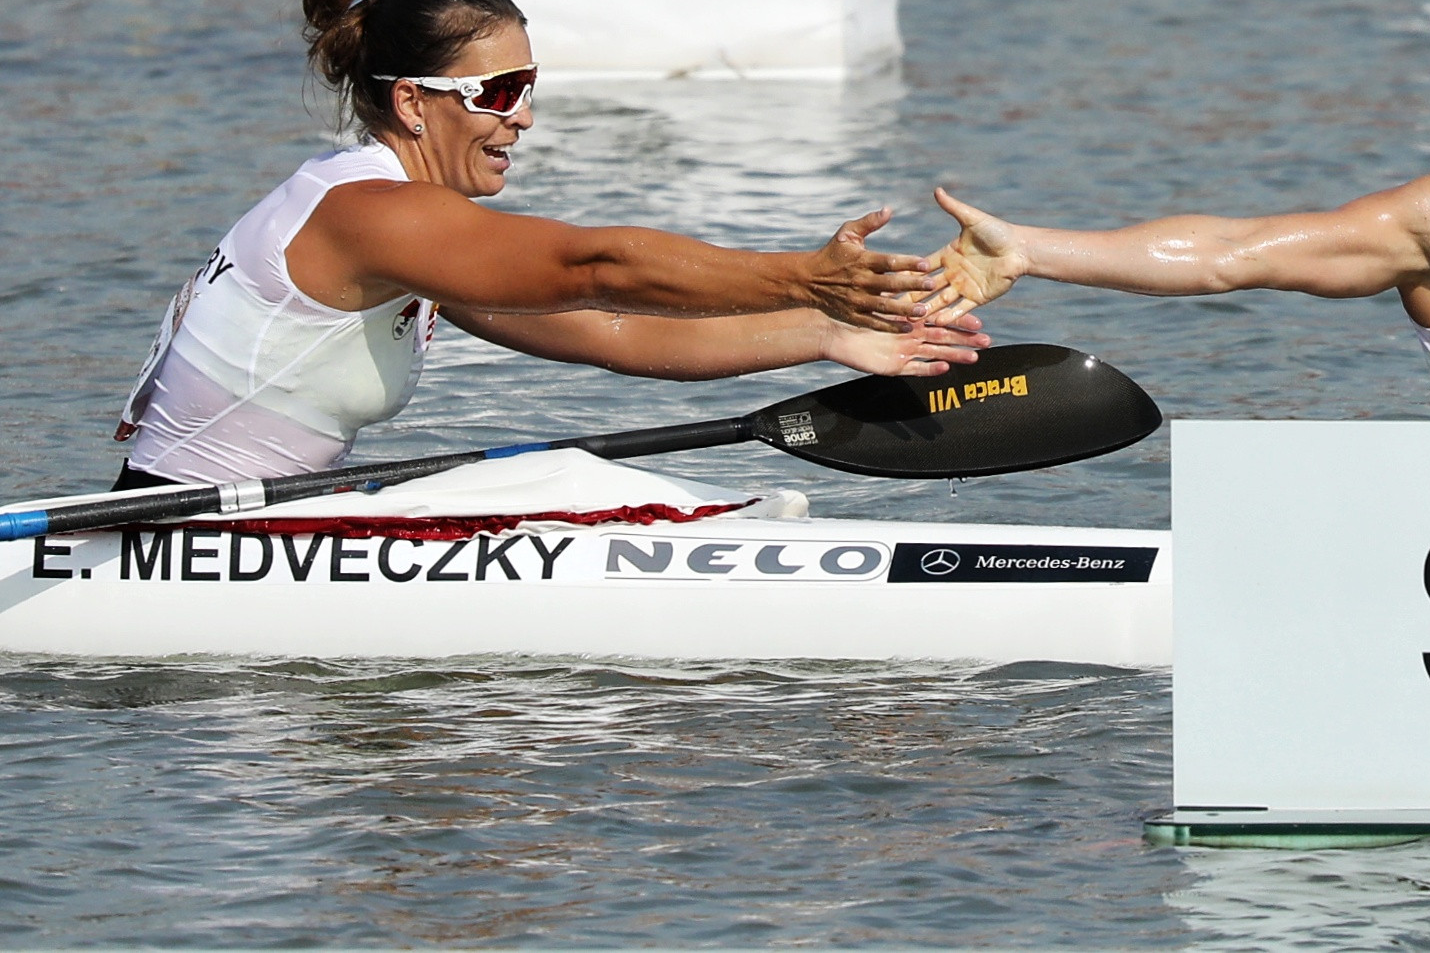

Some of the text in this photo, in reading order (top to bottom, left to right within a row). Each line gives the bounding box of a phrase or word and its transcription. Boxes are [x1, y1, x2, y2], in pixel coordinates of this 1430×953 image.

[928, 374, 1029, 414] Braća VII
[783, 431, 816, 444] canoe
[32, 529, 576, 583] E. MEDVECZKY
[605, 538, 883, 576] NELO
[975, 555, 1126, 570] Mercedes-Benz
